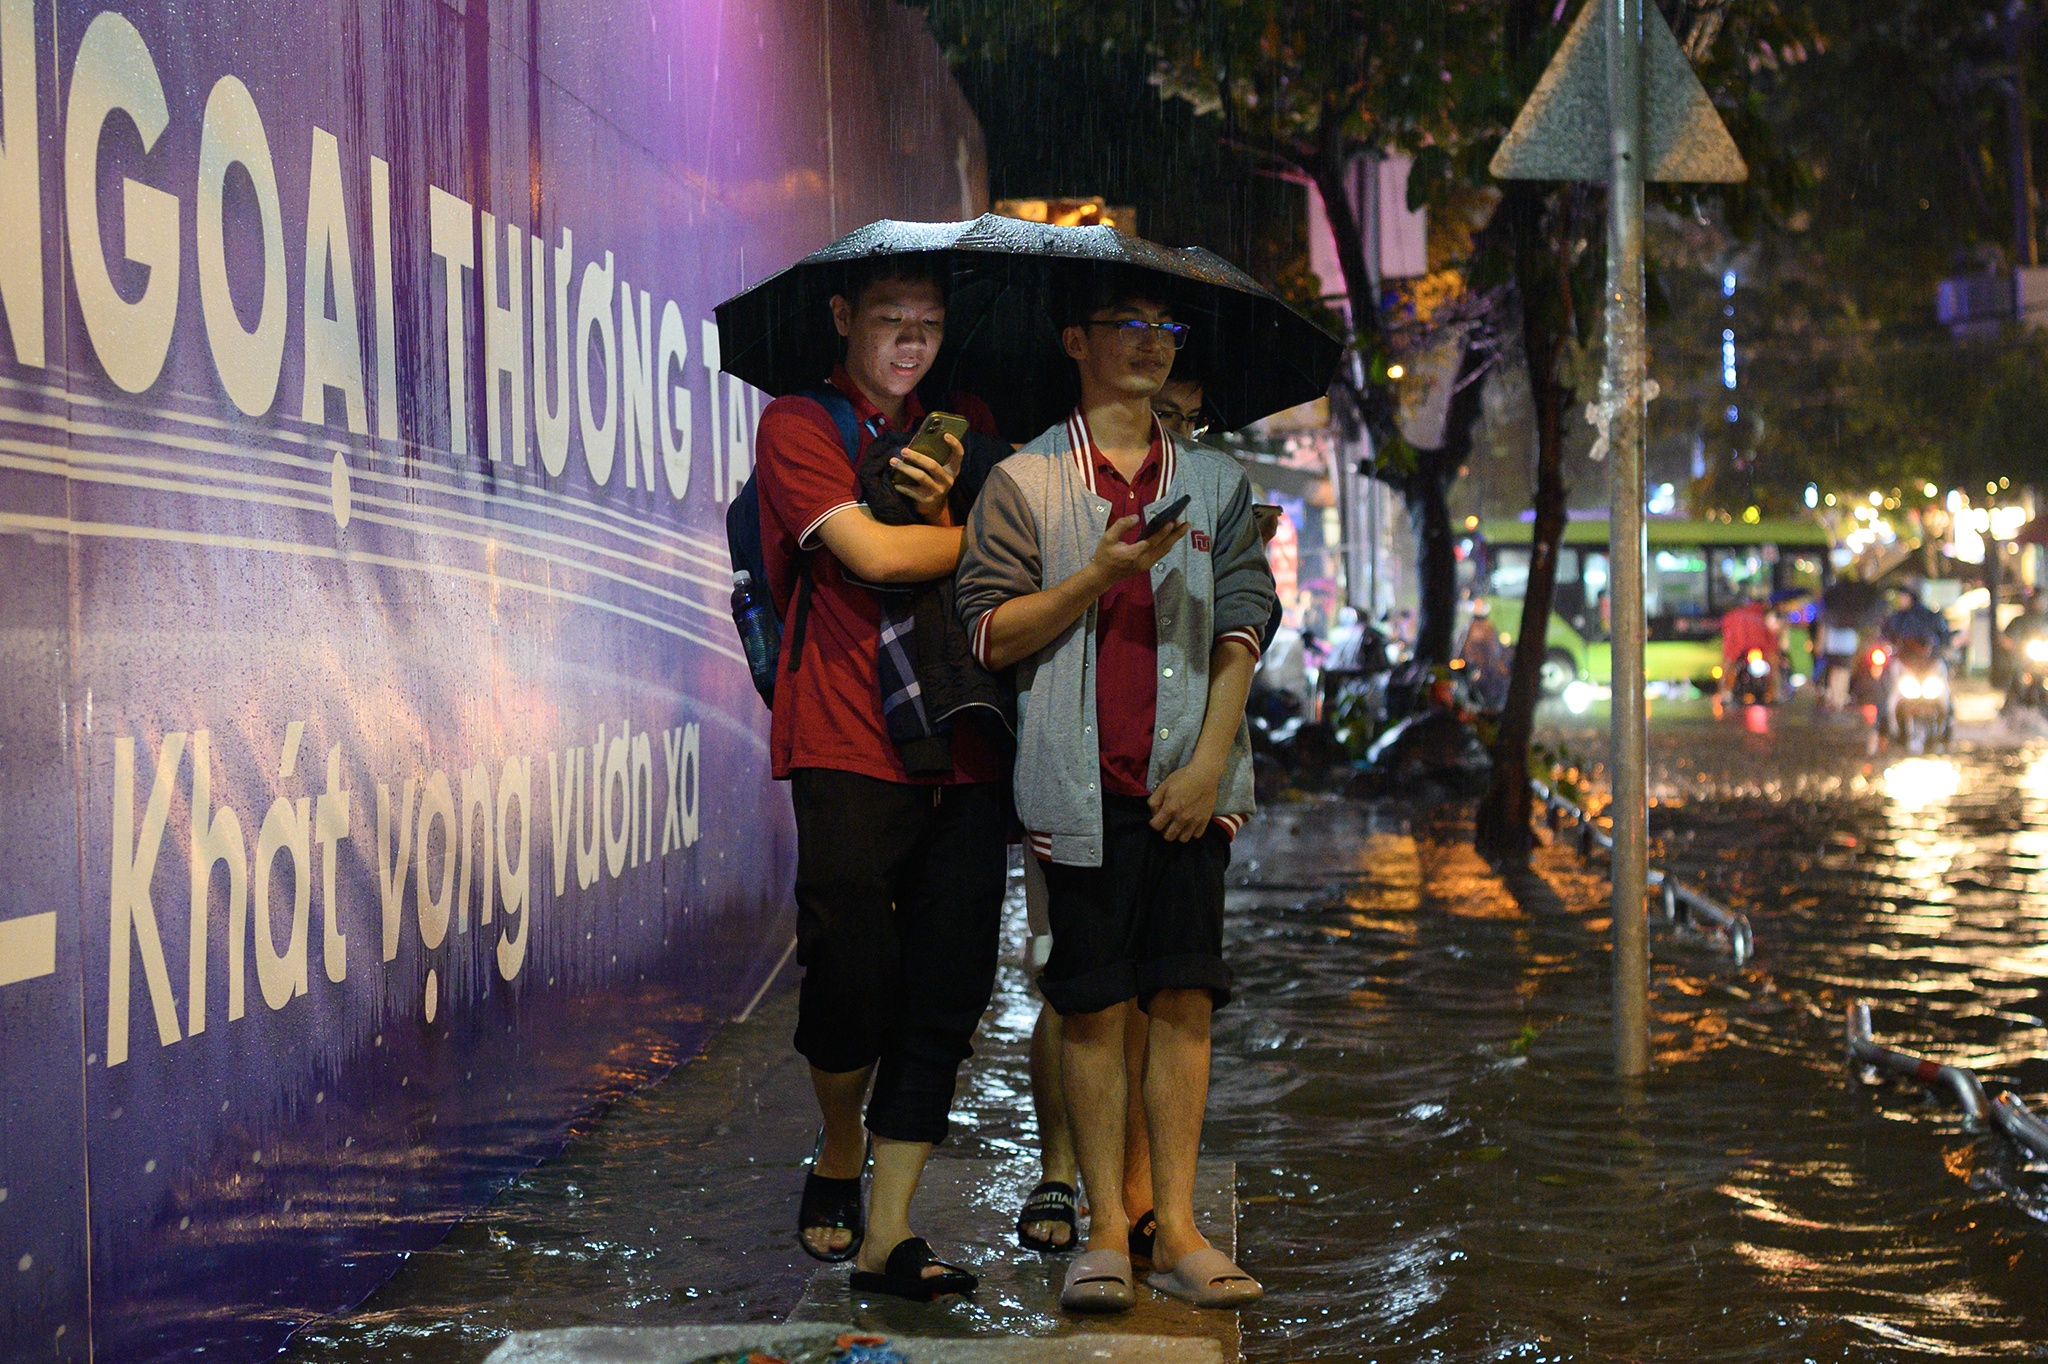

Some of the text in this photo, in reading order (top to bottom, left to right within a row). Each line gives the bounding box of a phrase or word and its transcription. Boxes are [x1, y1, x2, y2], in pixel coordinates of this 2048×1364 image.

[430, 184, 692, 500] THƯƠNG
[107, 720, 350, 1068] Khát
[377, 755, 531, 1024] vọng
[548, 720, 652, 897] vươn
[661, 722, 699, 856] xa
